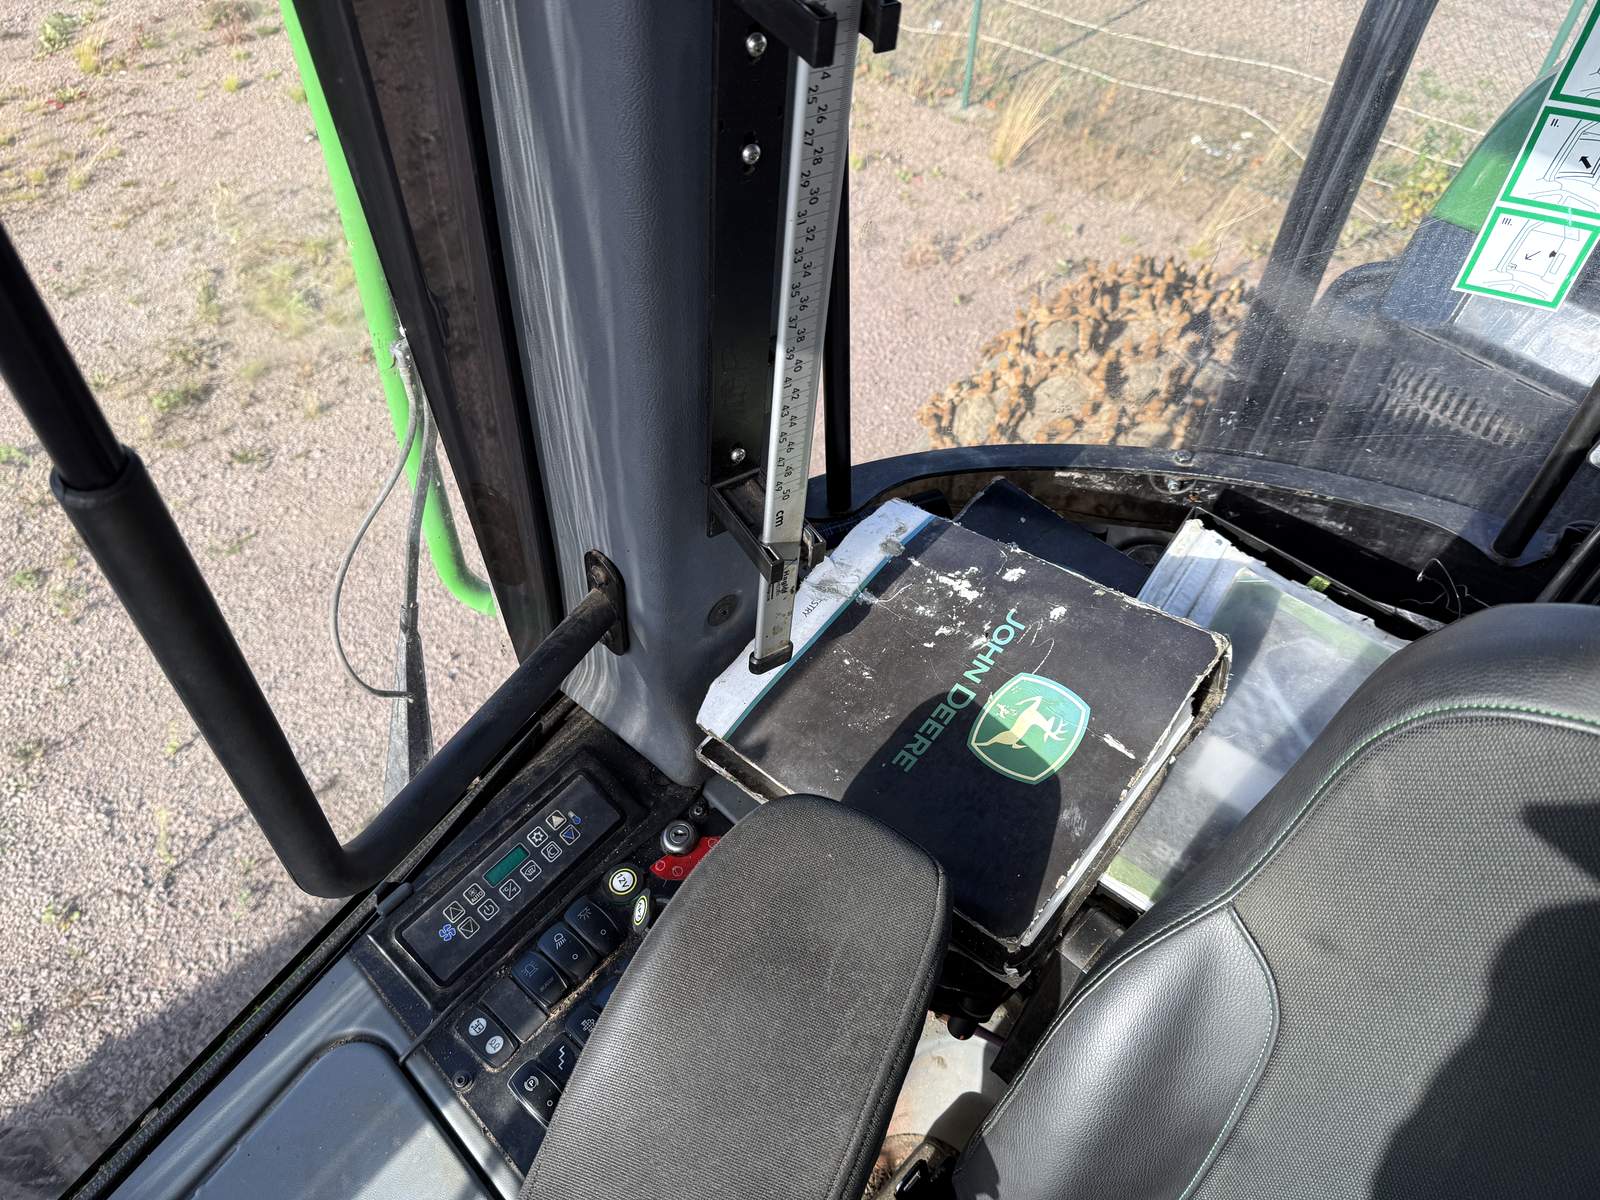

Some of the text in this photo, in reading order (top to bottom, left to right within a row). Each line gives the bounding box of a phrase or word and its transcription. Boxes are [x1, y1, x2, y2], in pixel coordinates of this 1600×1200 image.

[775, 71, 832, 527] 4 25 26 27 28 29 30 31 32 33 34 35 36 37 38 39 40 41 42 43 44 45 46 47 48 49 50 cm
[891, 607, 1026, 773] JOHN DEERE
[616, 873, 630, 888] 12V
